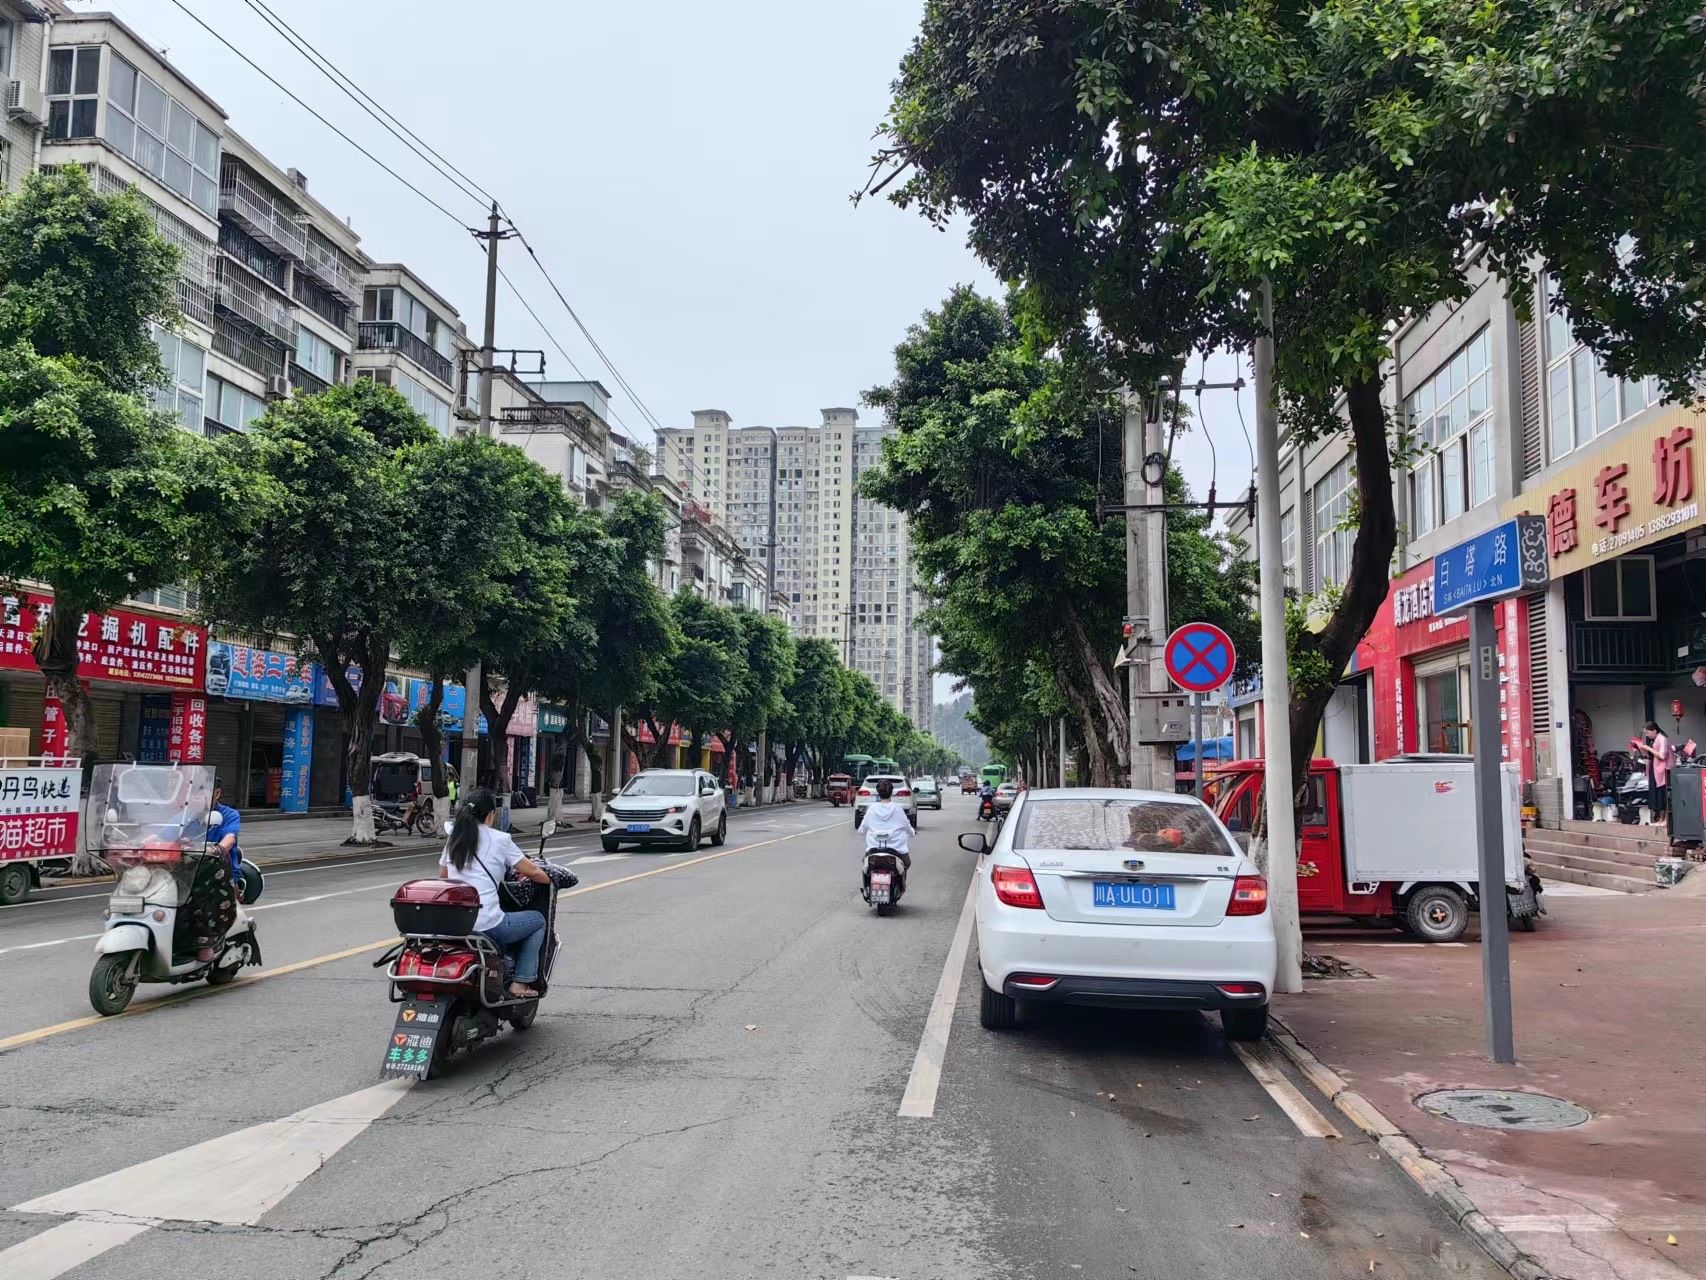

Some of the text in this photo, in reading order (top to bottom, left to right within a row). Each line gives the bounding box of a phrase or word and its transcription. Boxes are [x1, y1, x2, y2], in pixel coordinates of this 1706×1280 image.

[1546, 426, 1694, 559] 德车坊
[1648, 503, 1698, 534] 13882931011
[1440, 531, 1508, 589] 白塔路
[187, 698, 205, 759] 回收各类
[2, 775, 71, 801] 丹鸟快递
[0, 817, 67, 850] 猫超市
[415, 1012, 440, 1023] 雅迪
[388, 1046, 429, 1064] 车多多
[406, 1034, 433, 1048] 雅迪
